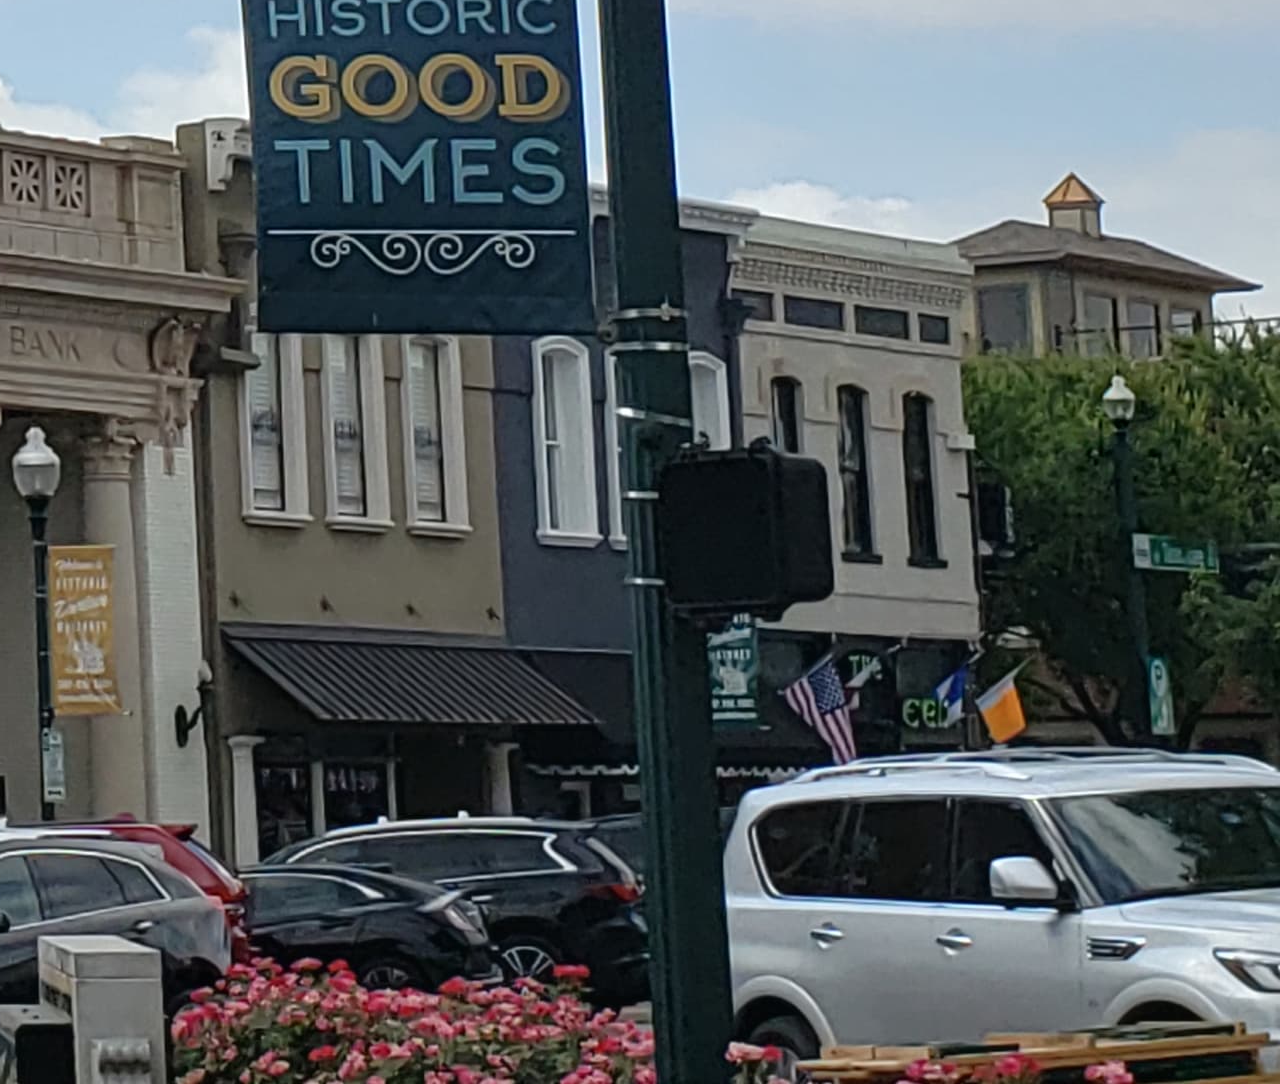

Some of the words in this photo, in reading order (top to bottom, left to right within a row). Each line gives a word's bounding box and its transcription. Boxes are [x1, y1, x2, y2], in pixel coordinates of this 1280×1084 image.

[268, 53, 570, 123] GOOD
[273, 137, 566, 205] TIMES
[9, 325, 82, 362] BANK
